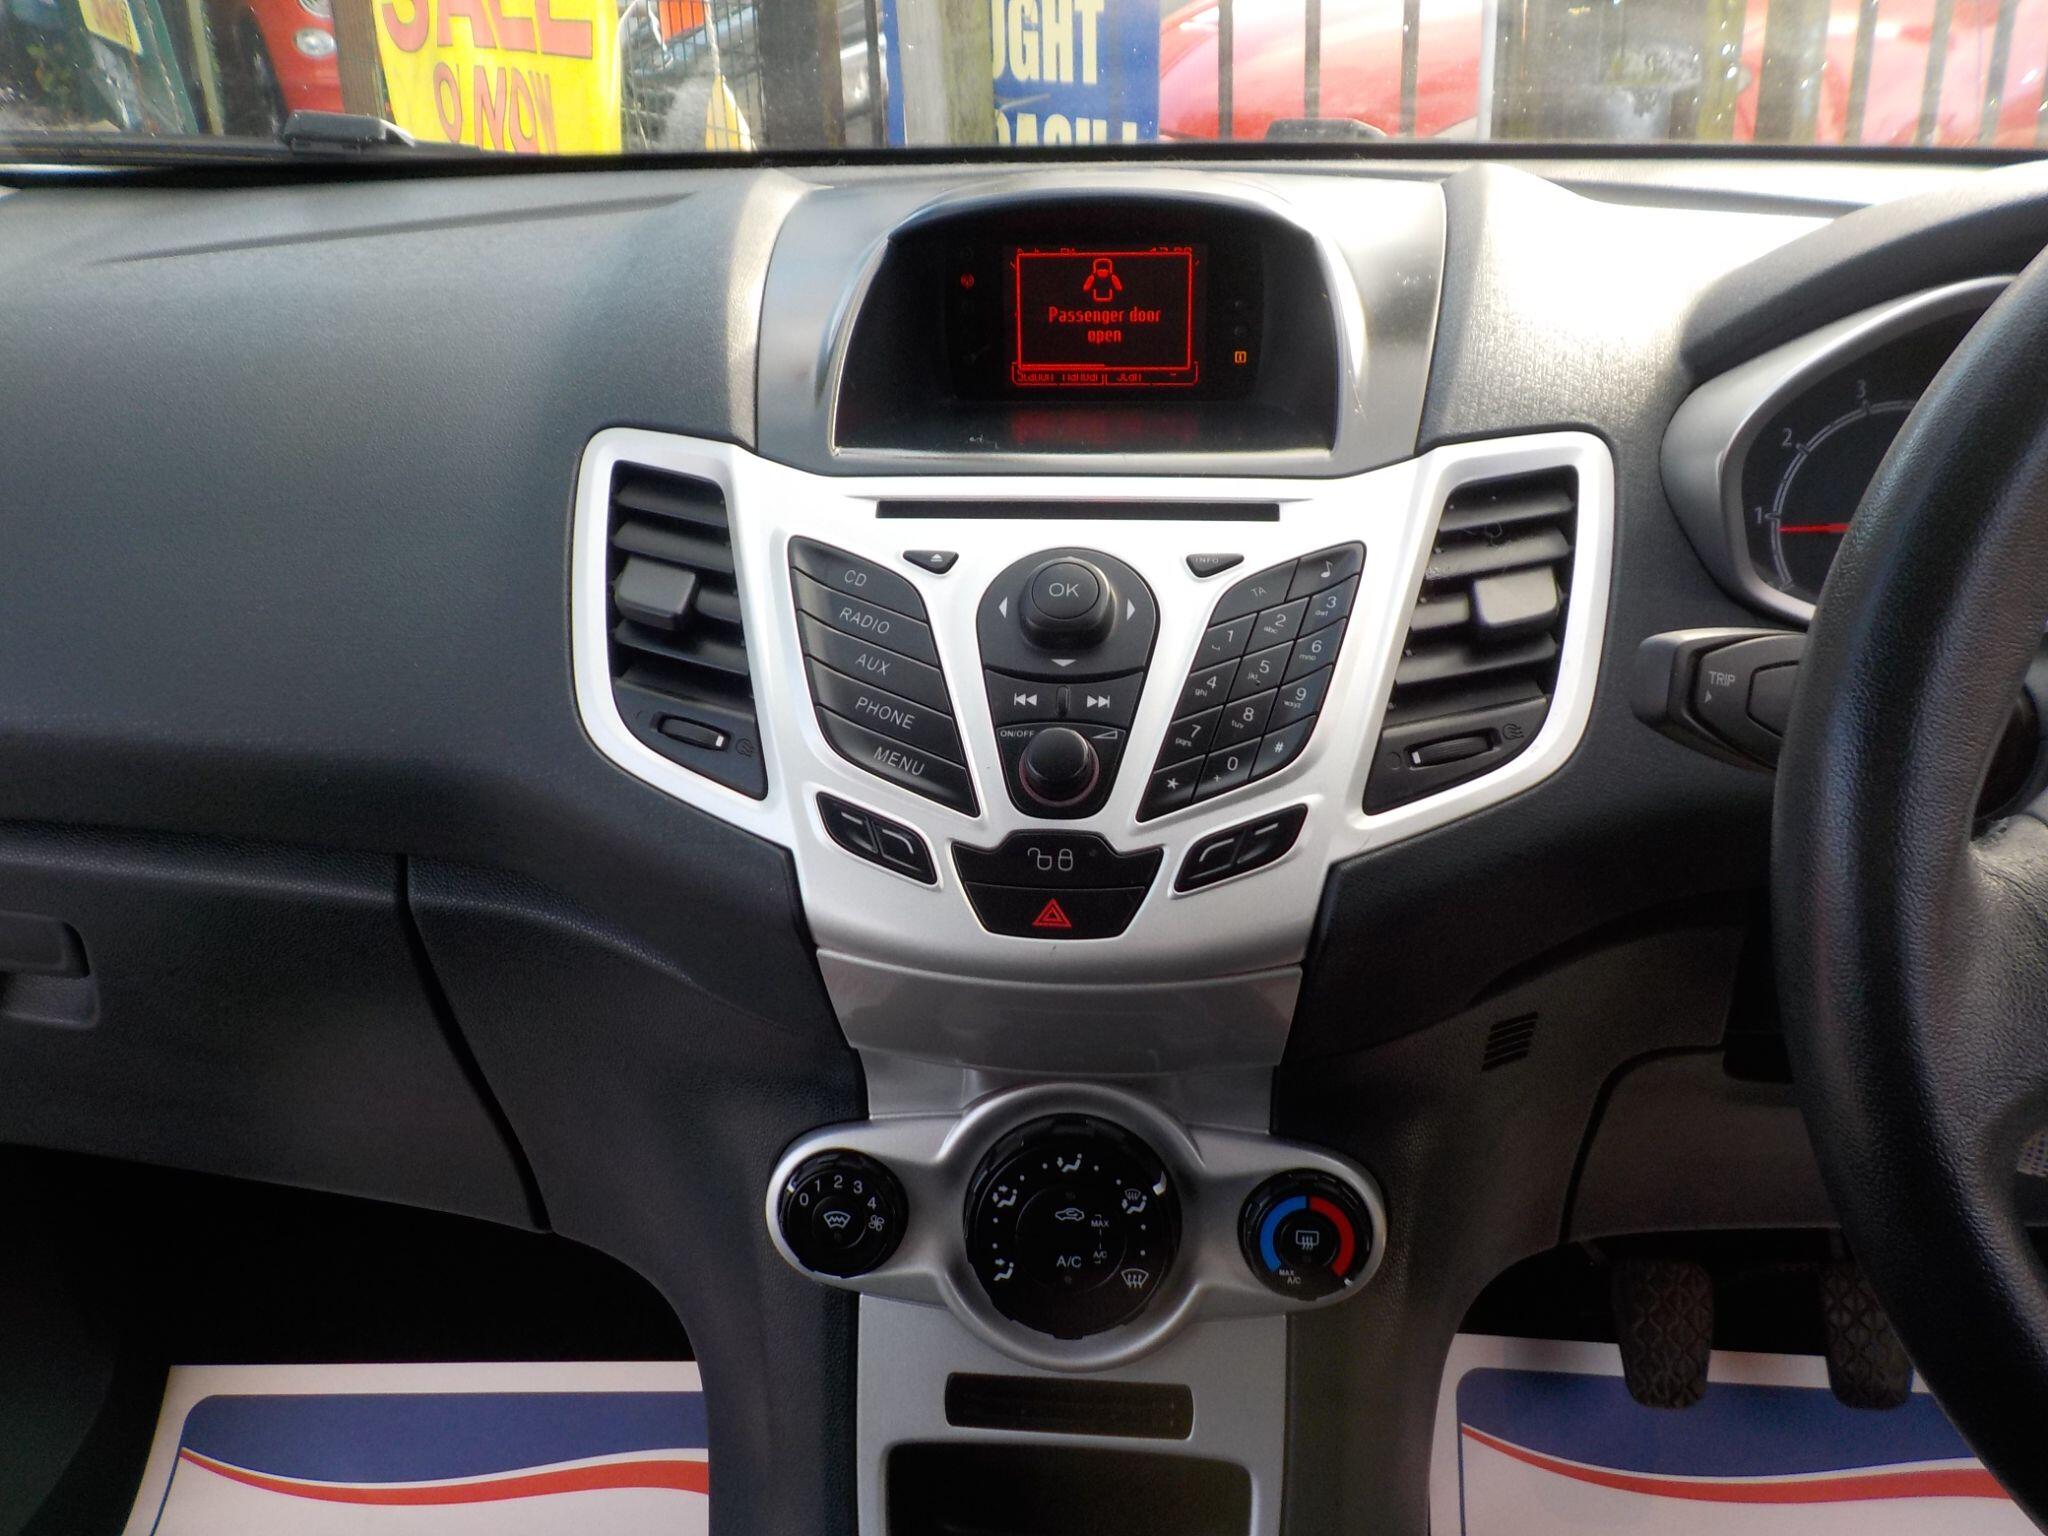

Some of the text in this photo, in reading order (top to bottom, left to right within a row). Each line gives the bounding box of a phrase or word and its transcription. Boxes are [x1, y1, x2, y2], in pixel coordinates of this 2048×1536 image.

[1048, 305, 1161, 325] Passenger door
[1087, 329, 1122, 344] open
[1857, 379, 1867, 398] 3
[1782, 427, 1793, 447] 2
[1754, 506, 1763, 524] 1
[844, 569, 867, 587] CD
[1049, 582, 1079, 597] OK
[1250, 586, 1267, 597] TA
[1326, 595, 1337, 608] 3
[839, 607, 890, 635] RADIO
[1275, 613, 1287, 627] 2
[1227, 630, 1234, 642] 1
[1311, 639, 1322, 653] 6
[855, 653, 890, 676] AUX
[1259, 660, 1270, 673] 5
[1206, 676, 1217, 689] 4
[1708, 670, 1736, 687] TRIP
[1295, 687, 1307, 701] 9
[855, 697, 915, 730] PHONE
[1243, 707, 1254, 721] 8
[1000, 729, 1034, 738] ON/OFF
[1191, 724, 1202, 738] 7
[874, 746, 925, 776] MENU
[1227, 756, 1238, 771] 0
[815, 1179, 820, 1192] 1
[834, 1175, 843, 1189] 2
[854, 1180, 863, 1194] 3
[800, 1193, 809, 1206] 0
[867, 1196, 876, 1209] 4
[1091, 1219, 1110, 1227] MAX
[1056, 1255, 1082, 1268] A/C
[1093, 1250, 1108, 1259] A/C
